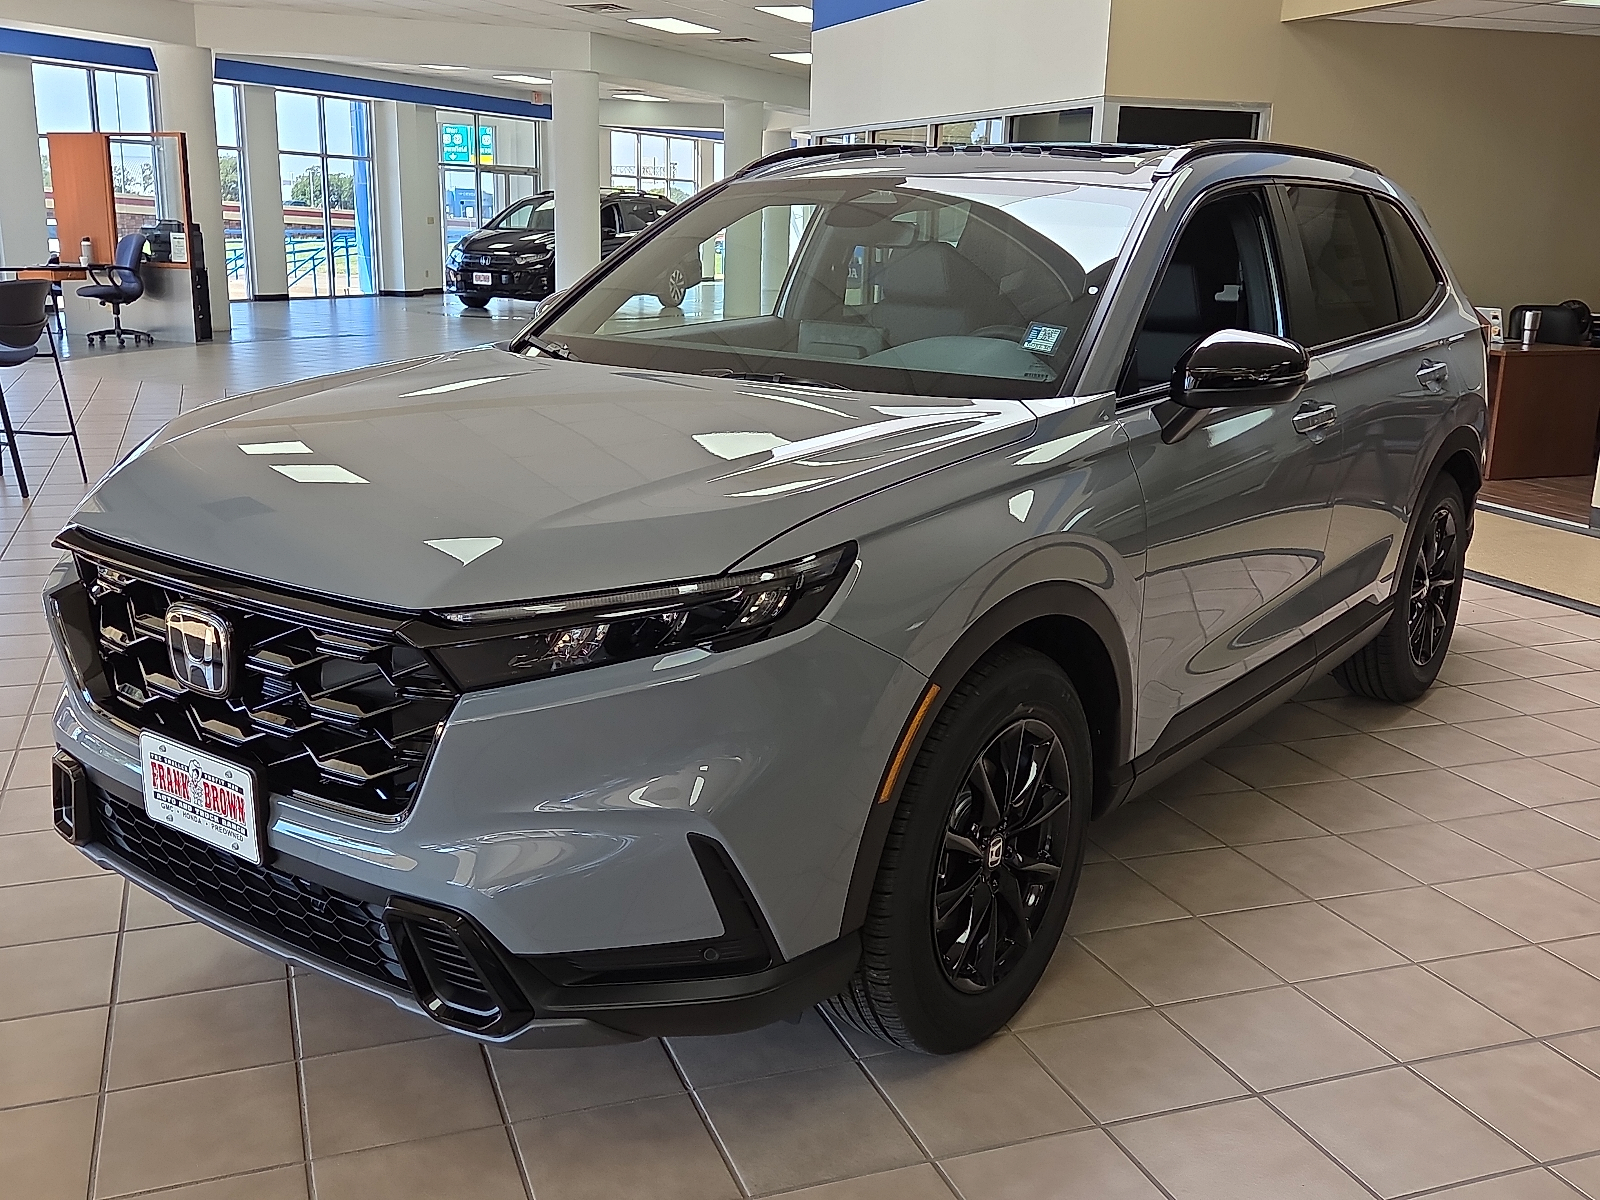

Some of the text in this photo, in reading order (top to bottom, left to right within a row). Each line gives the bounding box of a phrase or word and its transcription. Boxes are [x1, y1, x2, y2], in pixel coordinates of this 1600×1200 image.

[151, 761, 245, 823] FRANK BROWN
[156, 793, 246, 834] AUTO AND TRUCK RANCH
[161, 803, 244, 842] GMC HONDA PREOWNED
